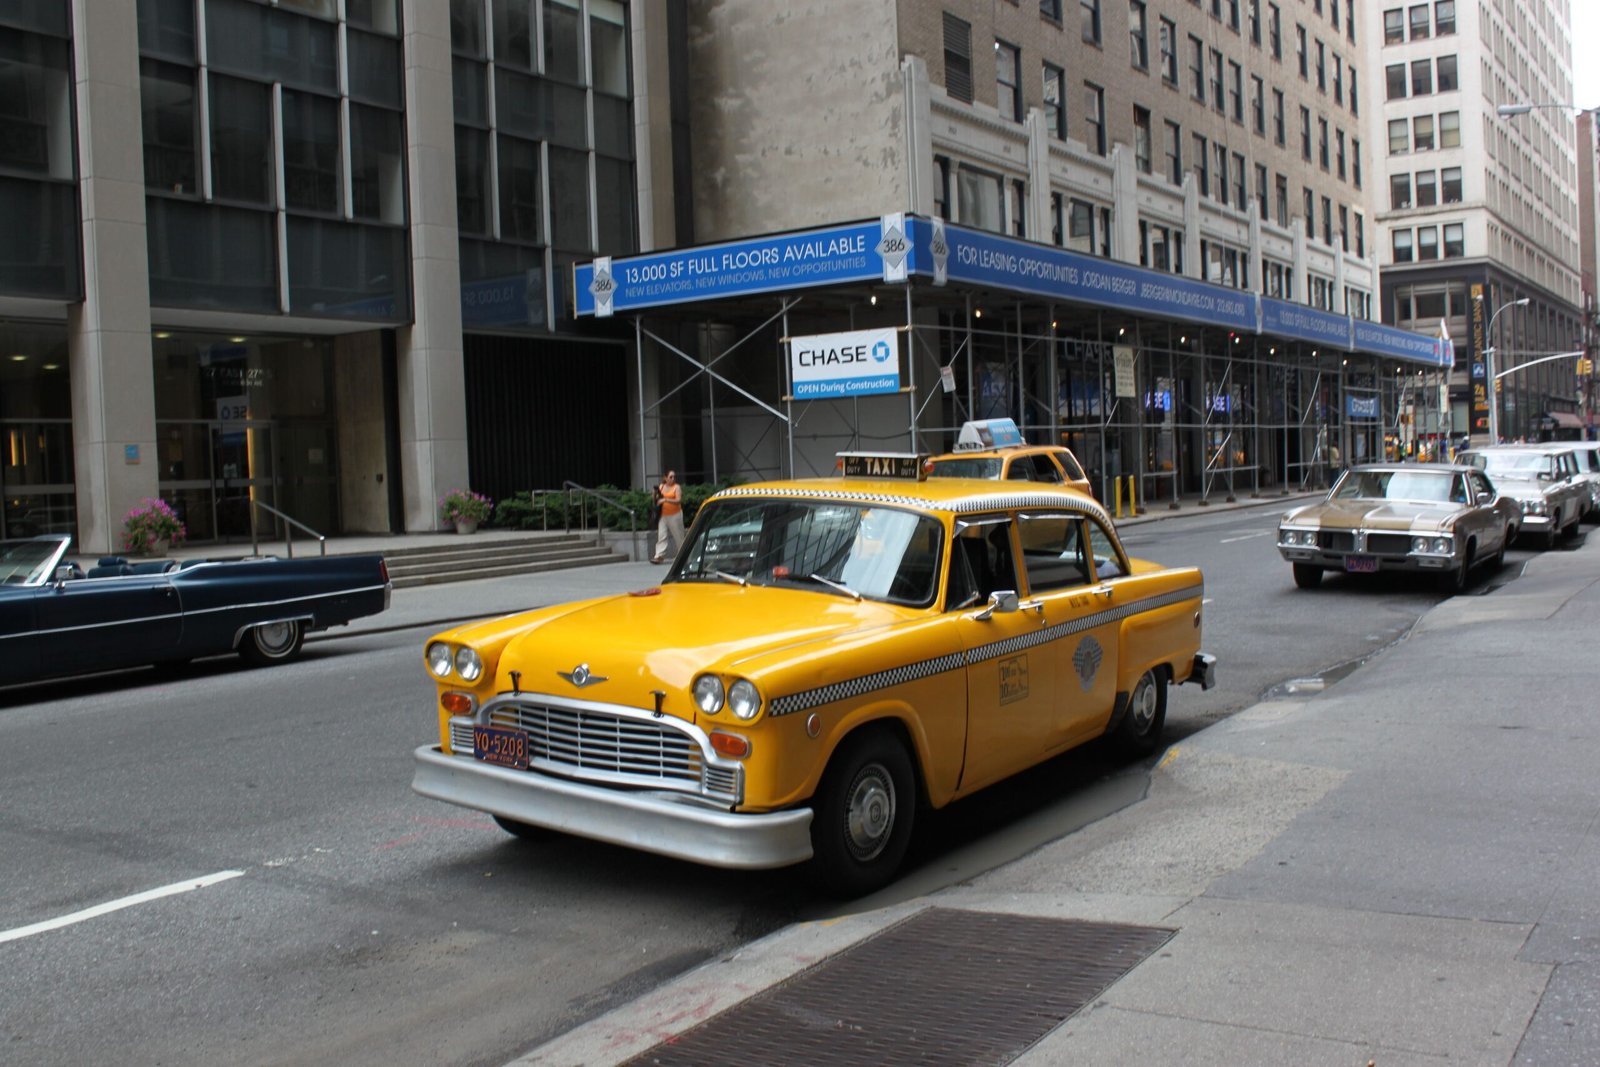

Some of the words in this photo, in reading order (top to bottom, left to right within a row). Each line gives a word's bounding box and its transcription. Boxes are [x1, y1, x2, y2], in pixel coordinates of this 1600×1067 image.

[883, 238, 905, 254] 386
[626, 264, 667, 283] 13,000
[670, 261, 684, 278] SF
[688, 257, 718, 275] FULL
[722, 247, 779, 270] FLOORS
[783, 235, 866, 262] AVAILABLE
[625, 287, 645, 298] NEW
[646, 280, 694, 296] ELEVATORS,
[695, 276, 716, 289] NEW
[717, 269, 767, 286] WINDOWS,
[769, 266, 791, 279] NEW
[792, 256, 866, 276] OPPORTUNITIES
[957, 245, 977, 265] FOR
[979, 250, 1017, 273] LEASING
[1018, 258, 1079, 285] OPPORTUNITIES
[1081, 270, 1111, 290] JORDAN
[1111, 276, 1137, 296] BERGER
[594, 279, 612, 292] 386
[799, 345, 867, 367] CHASE
[797, 384, 819, 394] OPEN
[820, 383, 845, 393] During
[846, 379, 895, 391] Construction
[846, 466, 861, 474] DUTY
[865, 458, 896, 476] TAXI
[900, 468, 915, 477] DUTY
